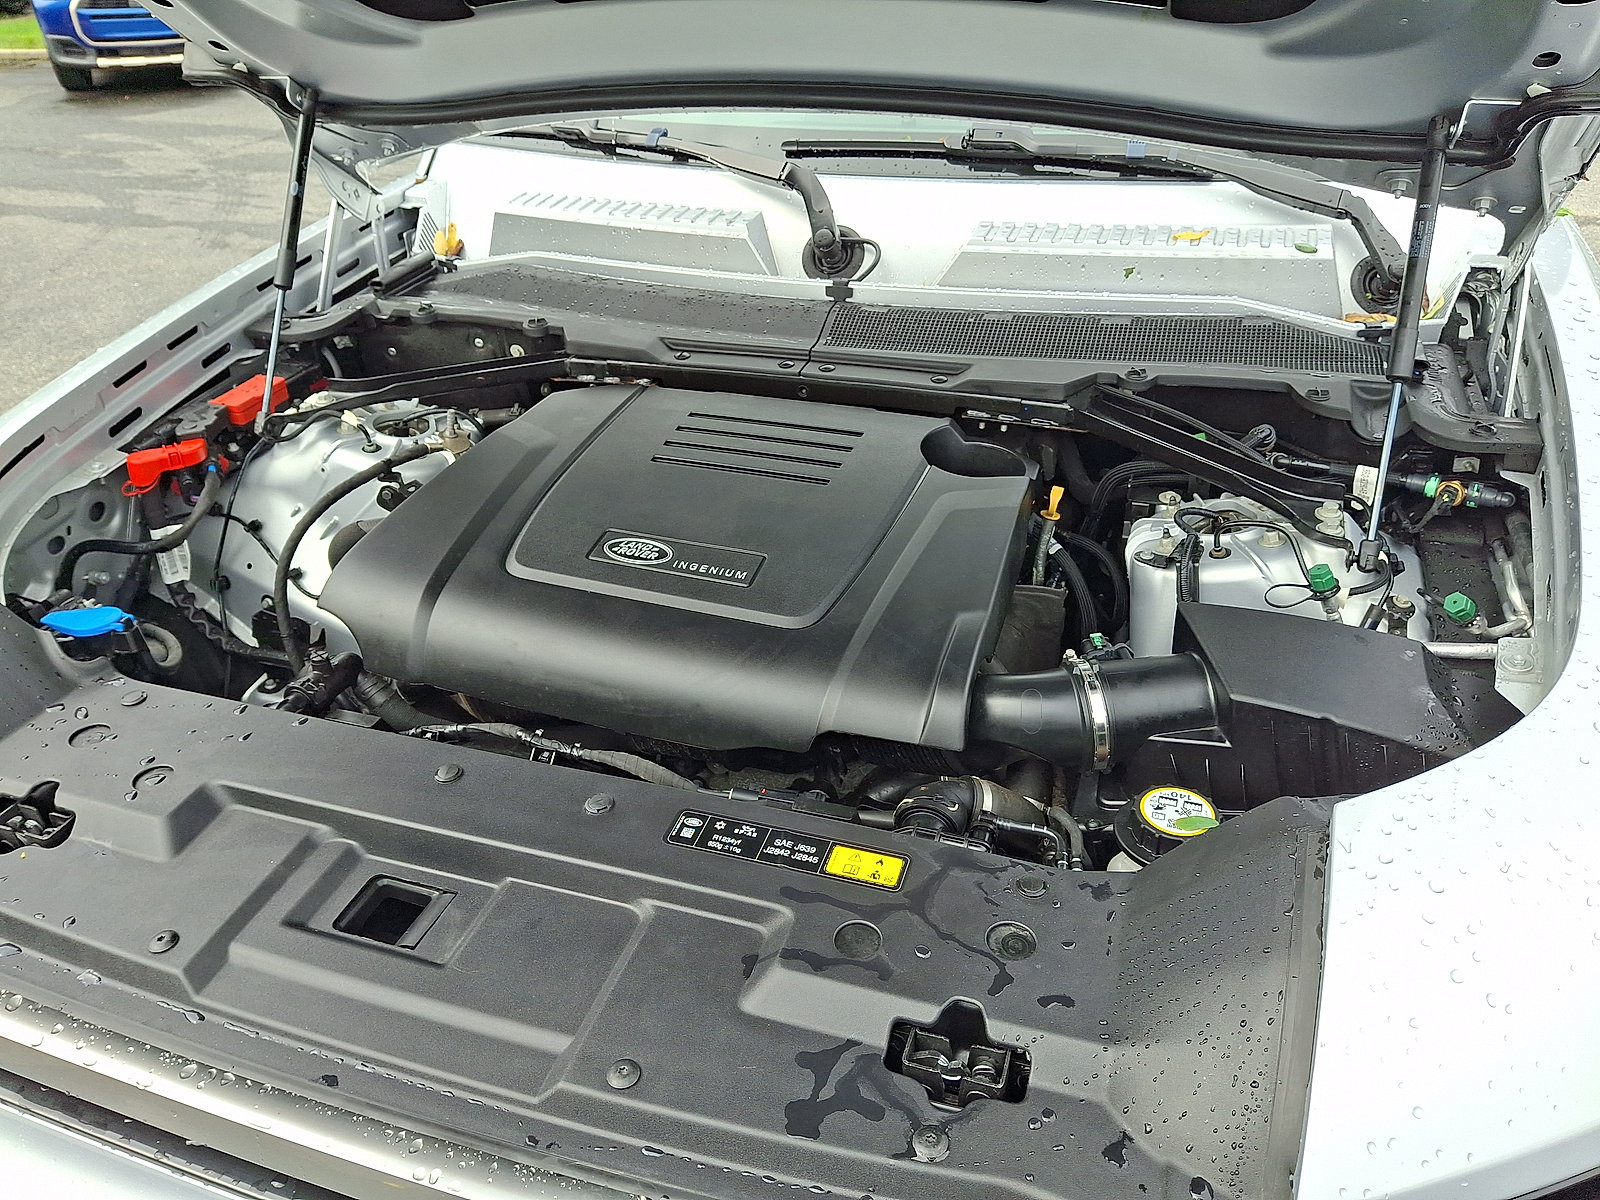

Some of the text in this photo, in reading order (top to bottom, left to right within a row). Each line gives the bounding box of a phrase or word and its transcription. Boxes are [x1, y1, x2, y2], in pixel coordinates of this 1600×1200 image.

[619, 540, 653, 551] LAND
[617, 547, 659, 559] ROVER
[672, 560, 748, 580] INGENIUM
[712, 834, 742, 846] R1234yf
[773, 838, 817, 854] SAE J639
[763, 846, 791, 857] J2842
[791, 852, 820, 864] J2845
